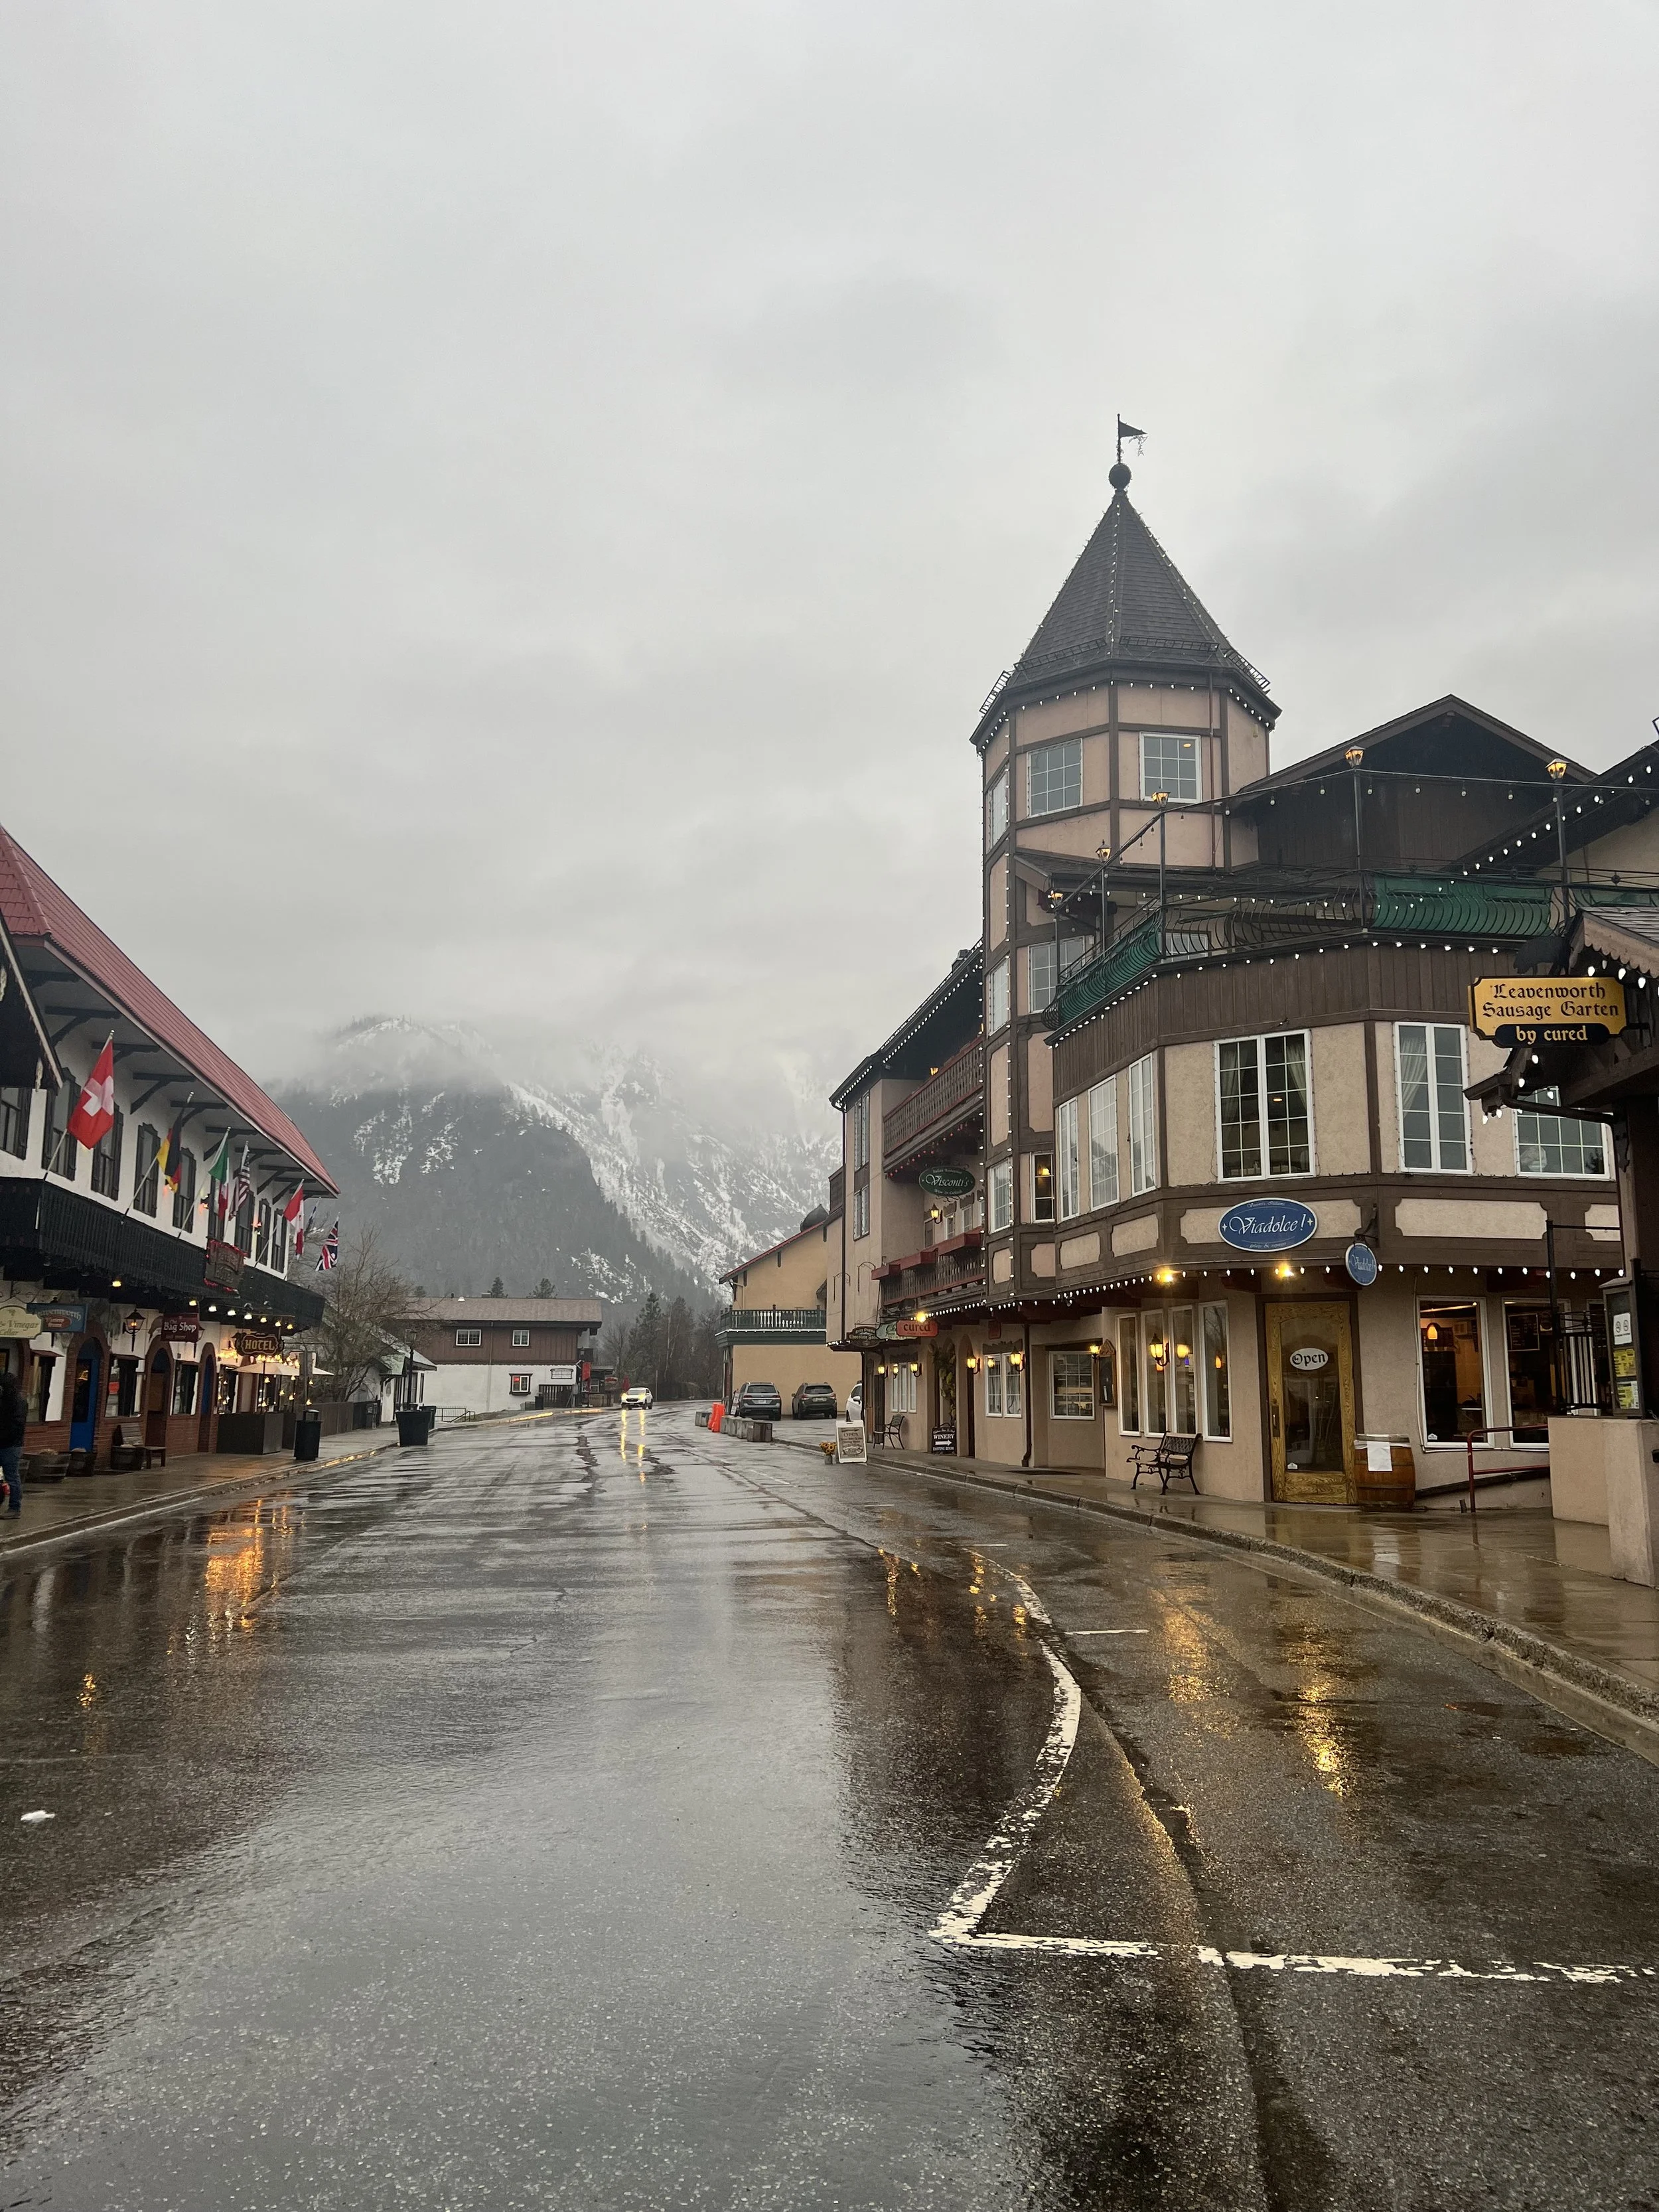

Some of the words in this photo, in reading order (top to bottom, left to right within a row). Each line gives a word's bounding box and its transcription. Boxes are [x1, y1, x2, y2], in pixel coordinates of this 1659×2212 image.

[1493, 982, 1605, 999] Leavenworth
[1482, 1001, 1551, 1020] Sausage
[1561, 1001, 1619, 1017] Garten
[1516, 1025, 1537, 1045] by
[1544, 1025, 1588, 1041] cured
[925, 1174, 969, 1187] Visconti's
[8, 1320, 39, 1330] Vinegar
[164, 1322, 178, 1333] Bag
[179, 1322, 196, 1333] Shop
[245, 1339, 275, 1351] HOTEL
[1292, 1353, 1326, 1366] Open
